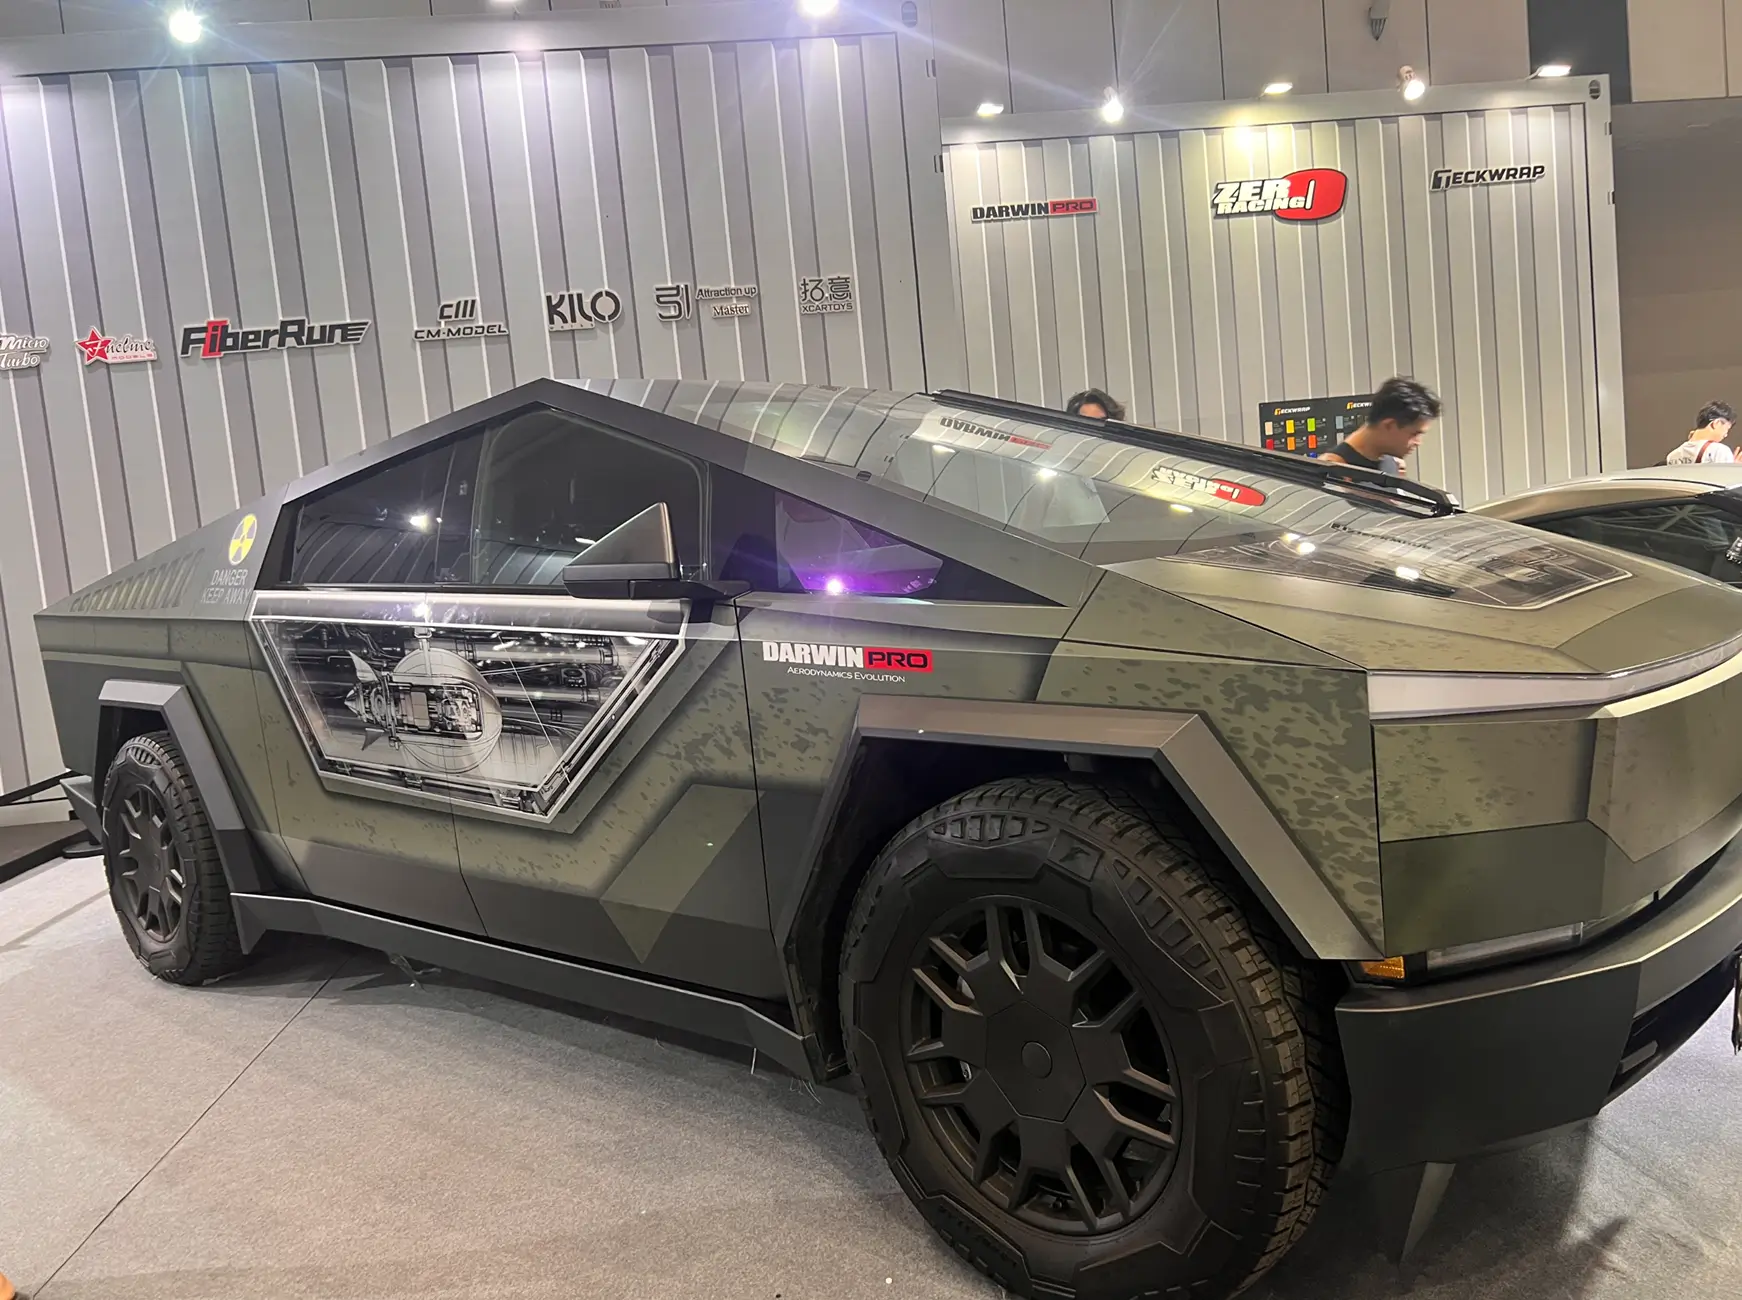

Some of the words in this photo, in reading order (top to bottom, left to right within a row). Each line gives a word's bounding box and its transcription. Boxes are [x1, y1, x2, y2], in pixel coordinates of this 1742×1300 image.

[1431, 165, 1545, 189] TECKWRAP
[972, 202, 1049, 220] DARWIN
[1053, 201, 1094, 213] PRO
[1217, 197, 1306, 215] RACING
[697, 287, 741, 299] Attraction
[744, 286, 757, 297] up
[546, 290, 621, 325] KILO
[713, 304, 749, 316] Master
[802, 303, 853, 313] XCARTOYS
[211, 569, 248, 586] DANGER
[201, 588, 224, 604] KEEP
[223, 588, 253, 604] AWAY
[762, 641, 864, 668] DARWIN
[868, 651, 928, 668] PRO
